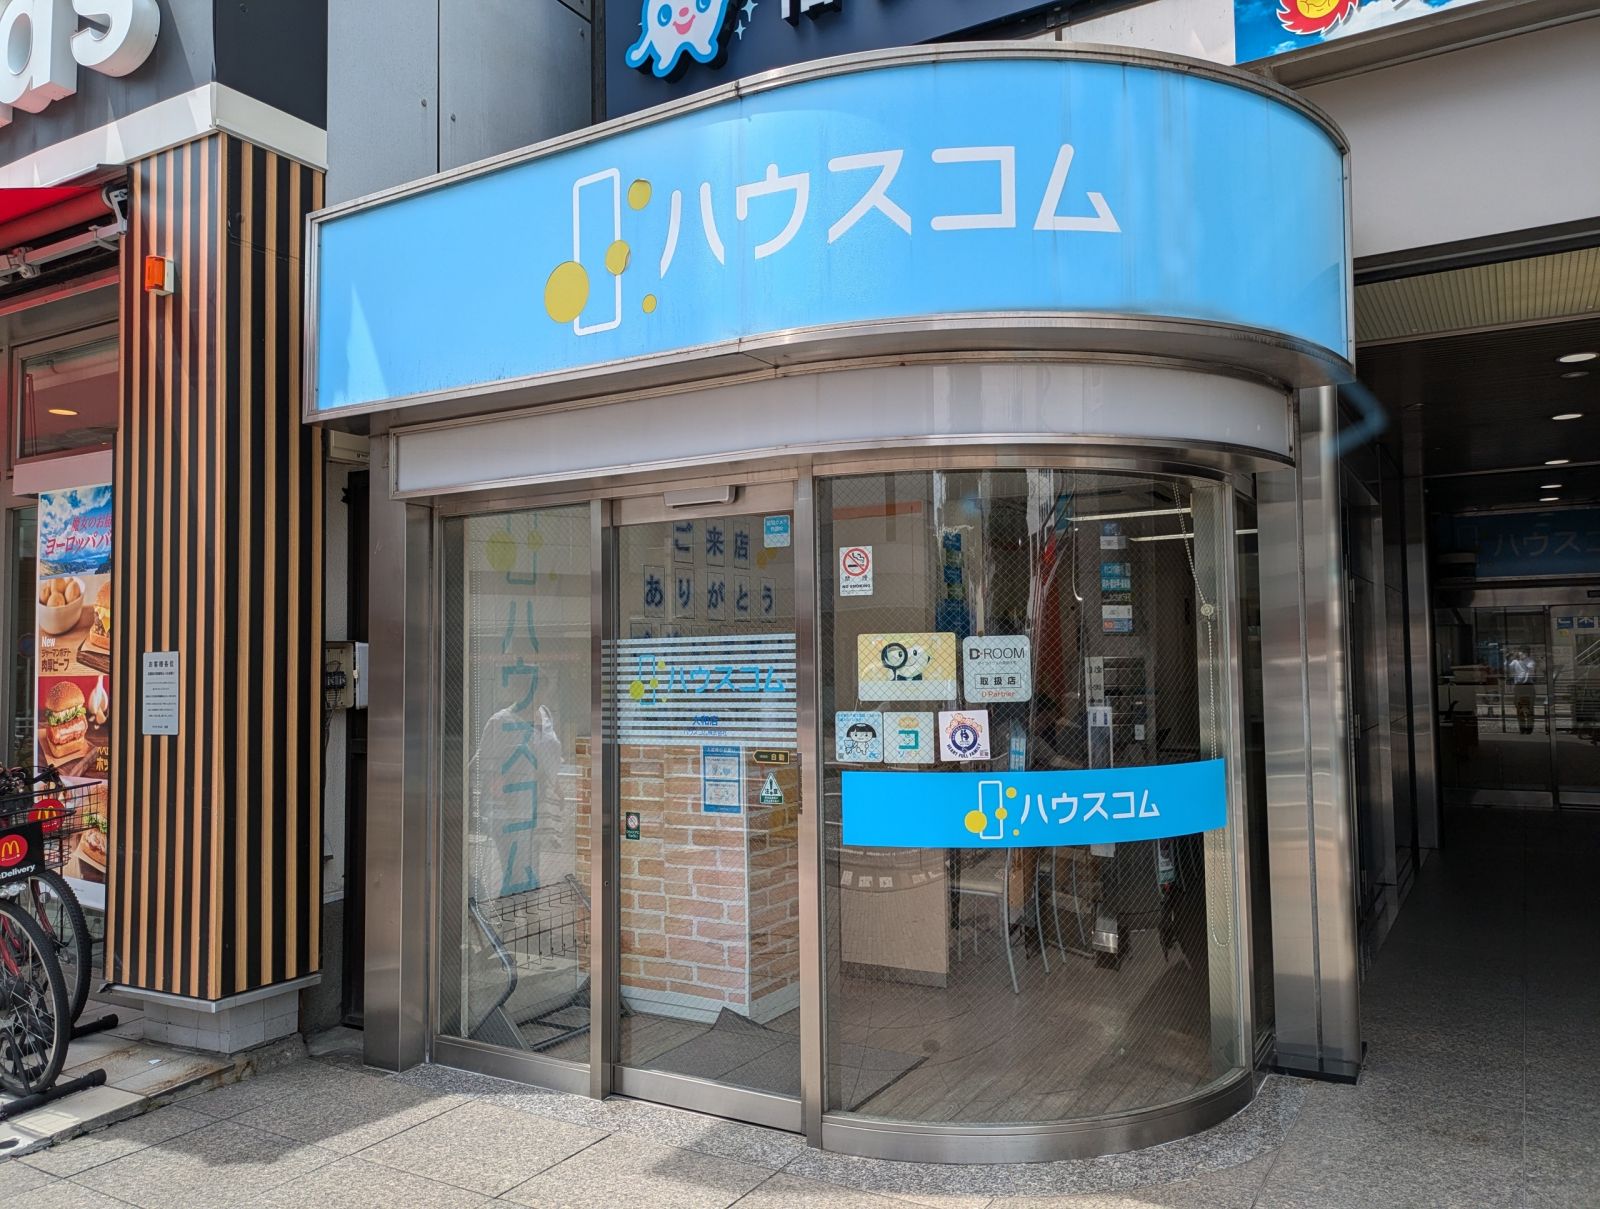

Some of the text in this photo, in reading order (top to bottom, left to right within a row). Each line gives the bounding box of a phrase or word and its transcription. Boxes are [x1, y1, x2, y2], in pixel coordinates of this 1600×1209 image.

[660, 143, 1122, 279] ハウスコム
[675, 522, 749, 560] ご来店
[645, 574, 773, 613] ありがとう
[41, 636, 56, 647] New
[41, 659, 70, 672] 肉厚ビーフ
[668, 666, 785, 693] ハウスコム
[980, 676, 1016, 686] 取扱店
[501, 599, 541, 897] ハウスコム
[1020, 789, 1160, 824] ハウスコム
[0, 864, 36, 879] Delivery
